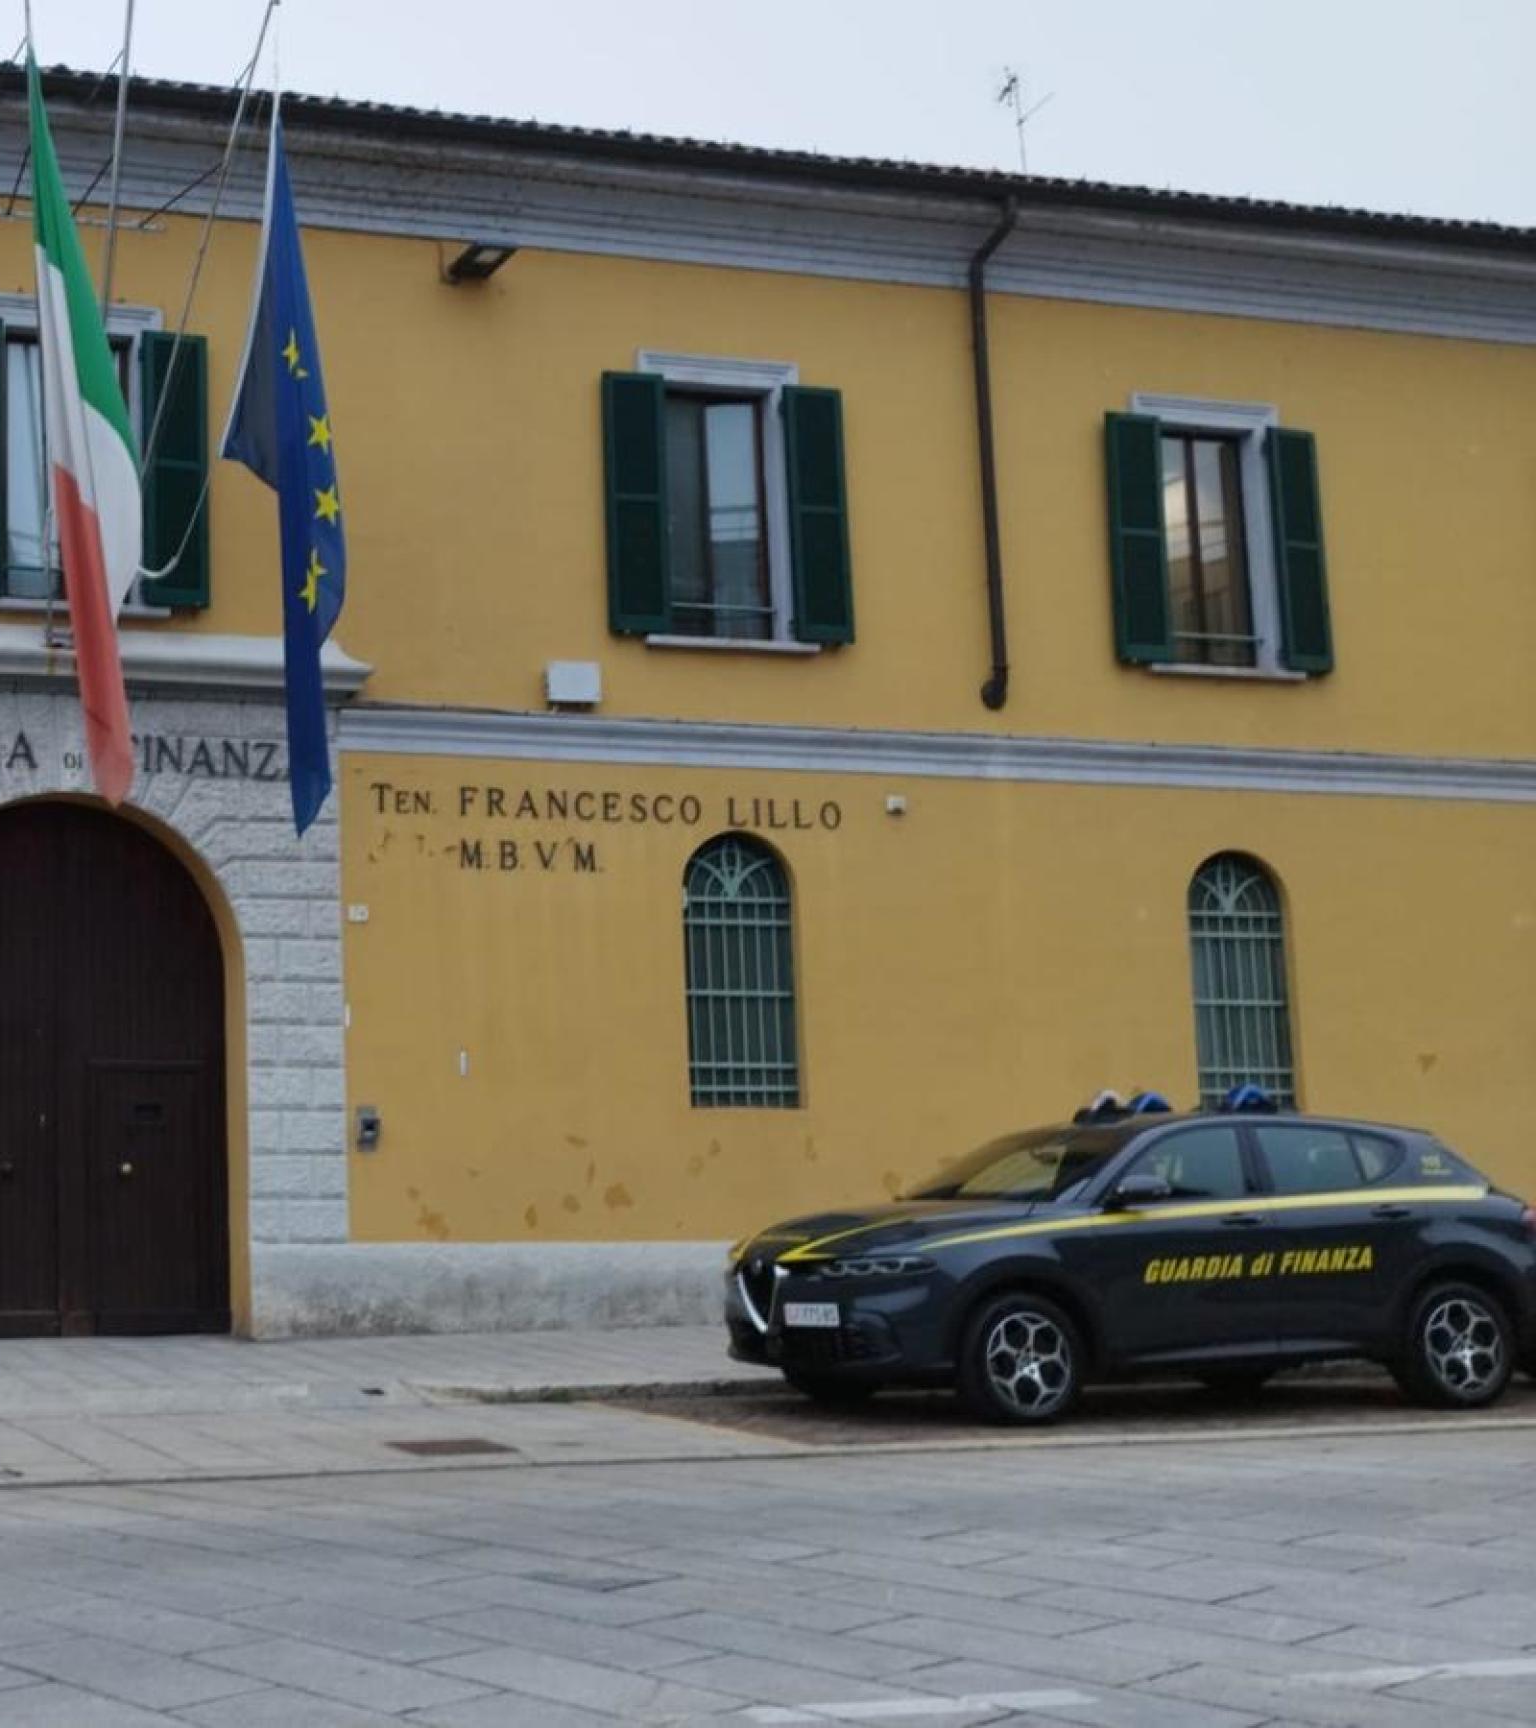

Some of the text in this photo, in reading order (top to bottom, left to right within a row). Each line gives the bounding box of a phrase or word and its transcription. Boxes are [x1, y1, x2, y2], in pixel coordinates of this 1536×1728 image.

[131, 733, 291, 783] INANZ
[460, 786, 702, 825] FRANCESCO
[727, 797, 842, 830] LILLO
[1144, 1254, 1243, 1283] GUARDIA
[1279, 1246, 1372, 1275] FINANZA
